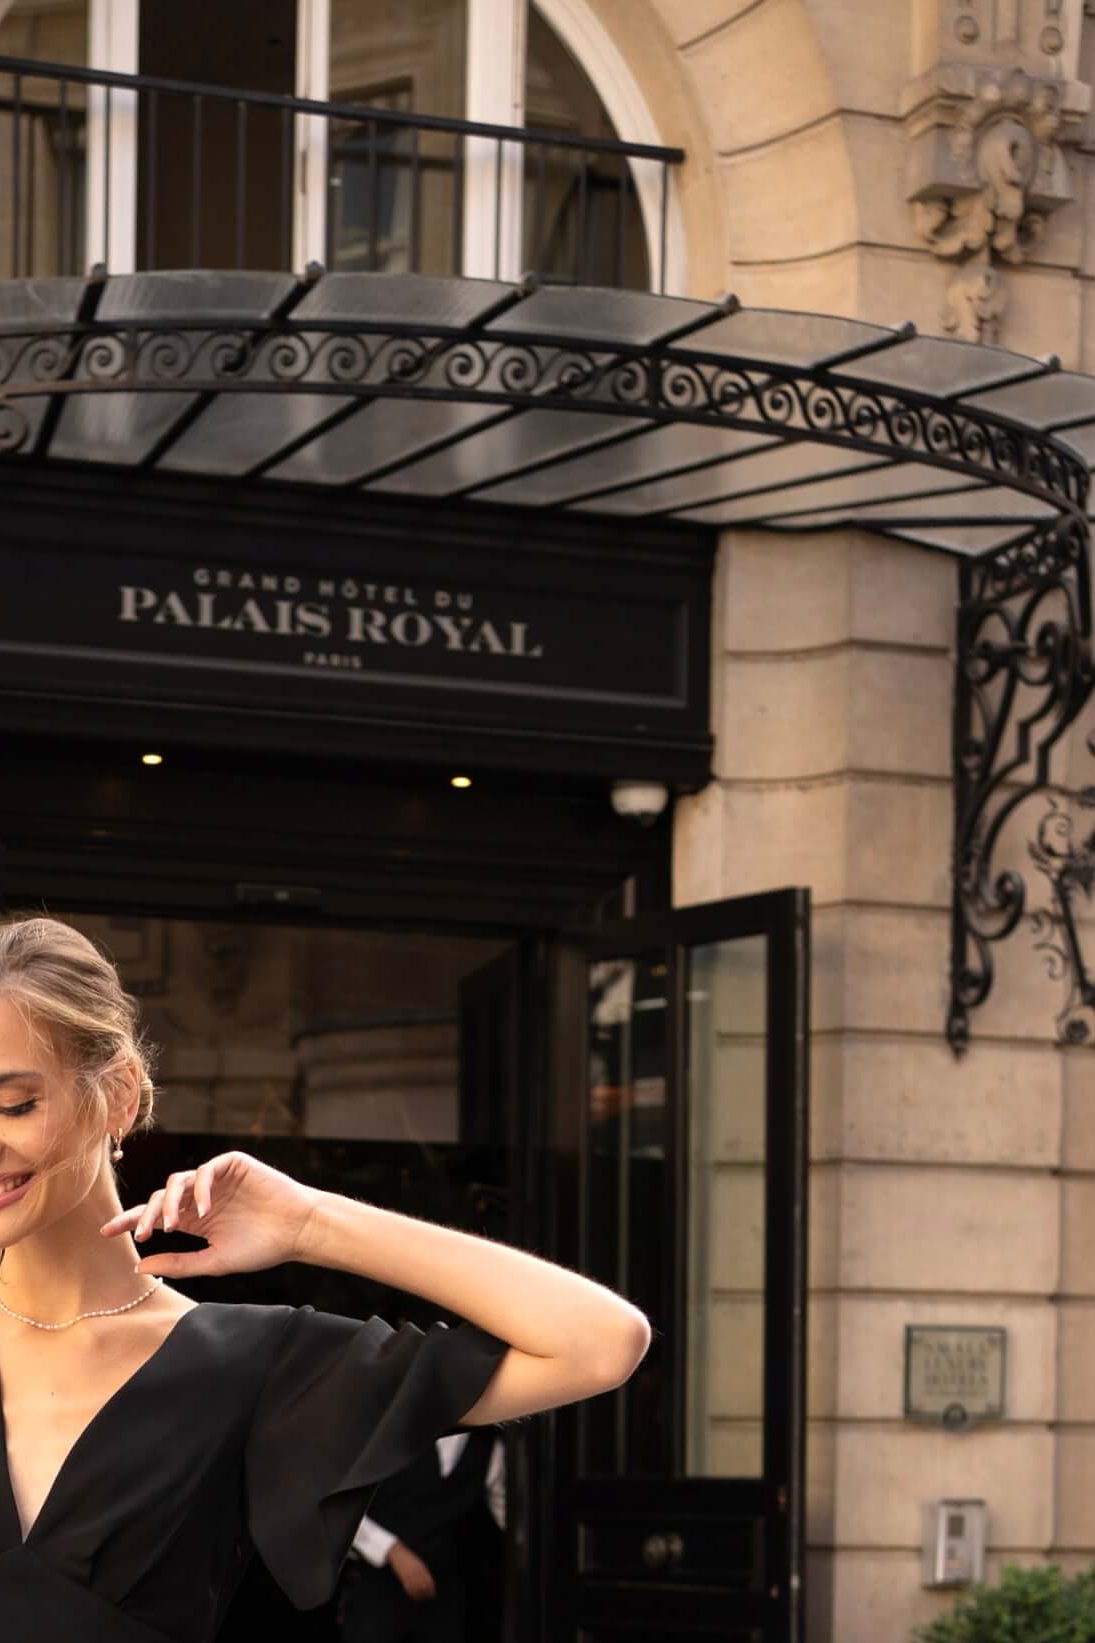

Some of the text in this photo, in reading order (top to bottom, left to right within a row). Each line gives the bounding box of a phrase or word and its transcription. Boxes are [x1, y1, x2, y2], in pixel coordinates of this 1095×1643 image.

[193, 567, 474, 610] GRAND HÔTEL DU
[118, 585, 543, 658] PALAIS ROYAL
[303, 651, 362, 669] PARIS
